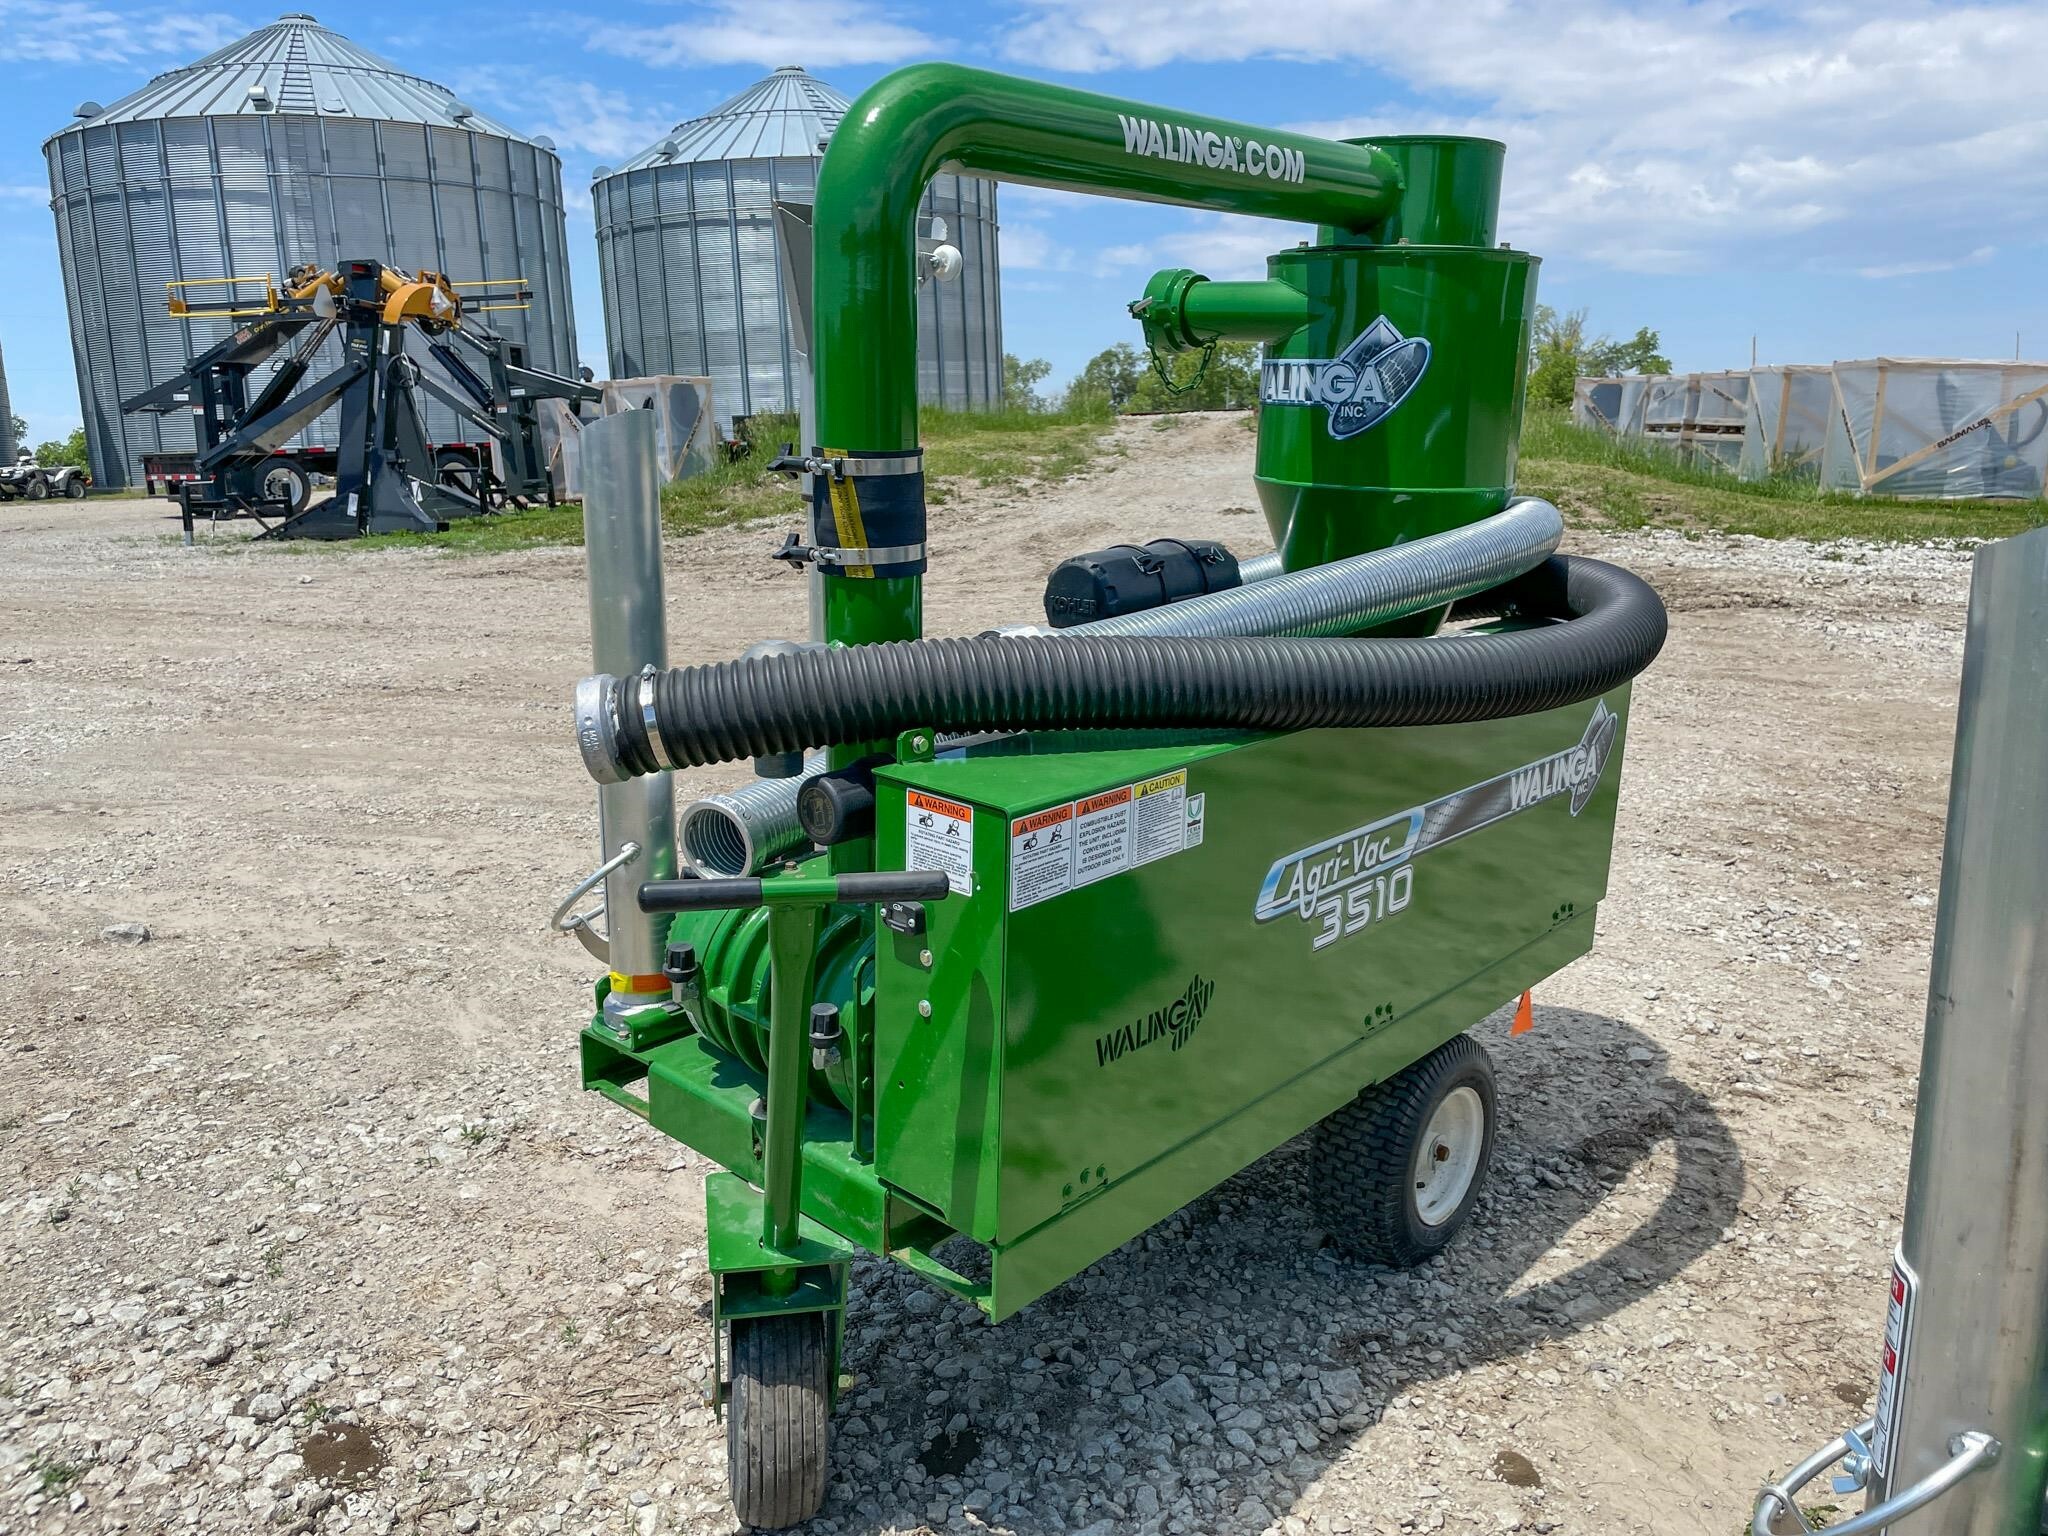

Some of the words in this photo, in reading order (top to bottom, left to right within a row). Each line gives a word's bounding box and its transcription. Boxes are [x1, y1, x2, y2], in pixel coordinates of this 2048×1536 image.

[1340, 405, 1367, 418] INC.
[1050, 595, 1097, 616] KOHLER
[1148, 775, 1181, 792] CAUTION
[1511, 743, 1598, 811] WALINGA
[924, 797, 966, 818] WARNING
[1091, 791, 1127, 810] WARNING
[1029, 809, 1068, 829] WARNING
[1080, 814, 1113, 830] COMBUSTIBLE
[1114, 809, 1127, 818] DUST
[1079, 826, 1106, 839] EXPLOSION
[1079, 839, 1089, 847] THE
[1102, 827, 1127, 841] INCLUDING
[1082, 843, 1109, 855] CONVEYING
[1082, 856, 1087, 864] IS
[1088, 850, 1111, 862] DESIGNED
[1112, 845, 1122, 854] FOR
[1077, 861, 1101, 874] OUTDOOR
[1102, 857, 1111, 867] USE
[1286, 833, 1393, 920] Agri-Vac
[1312, 864, 1413, 952] 3510
[1095, 992, 1203, 1068] WALINGA
